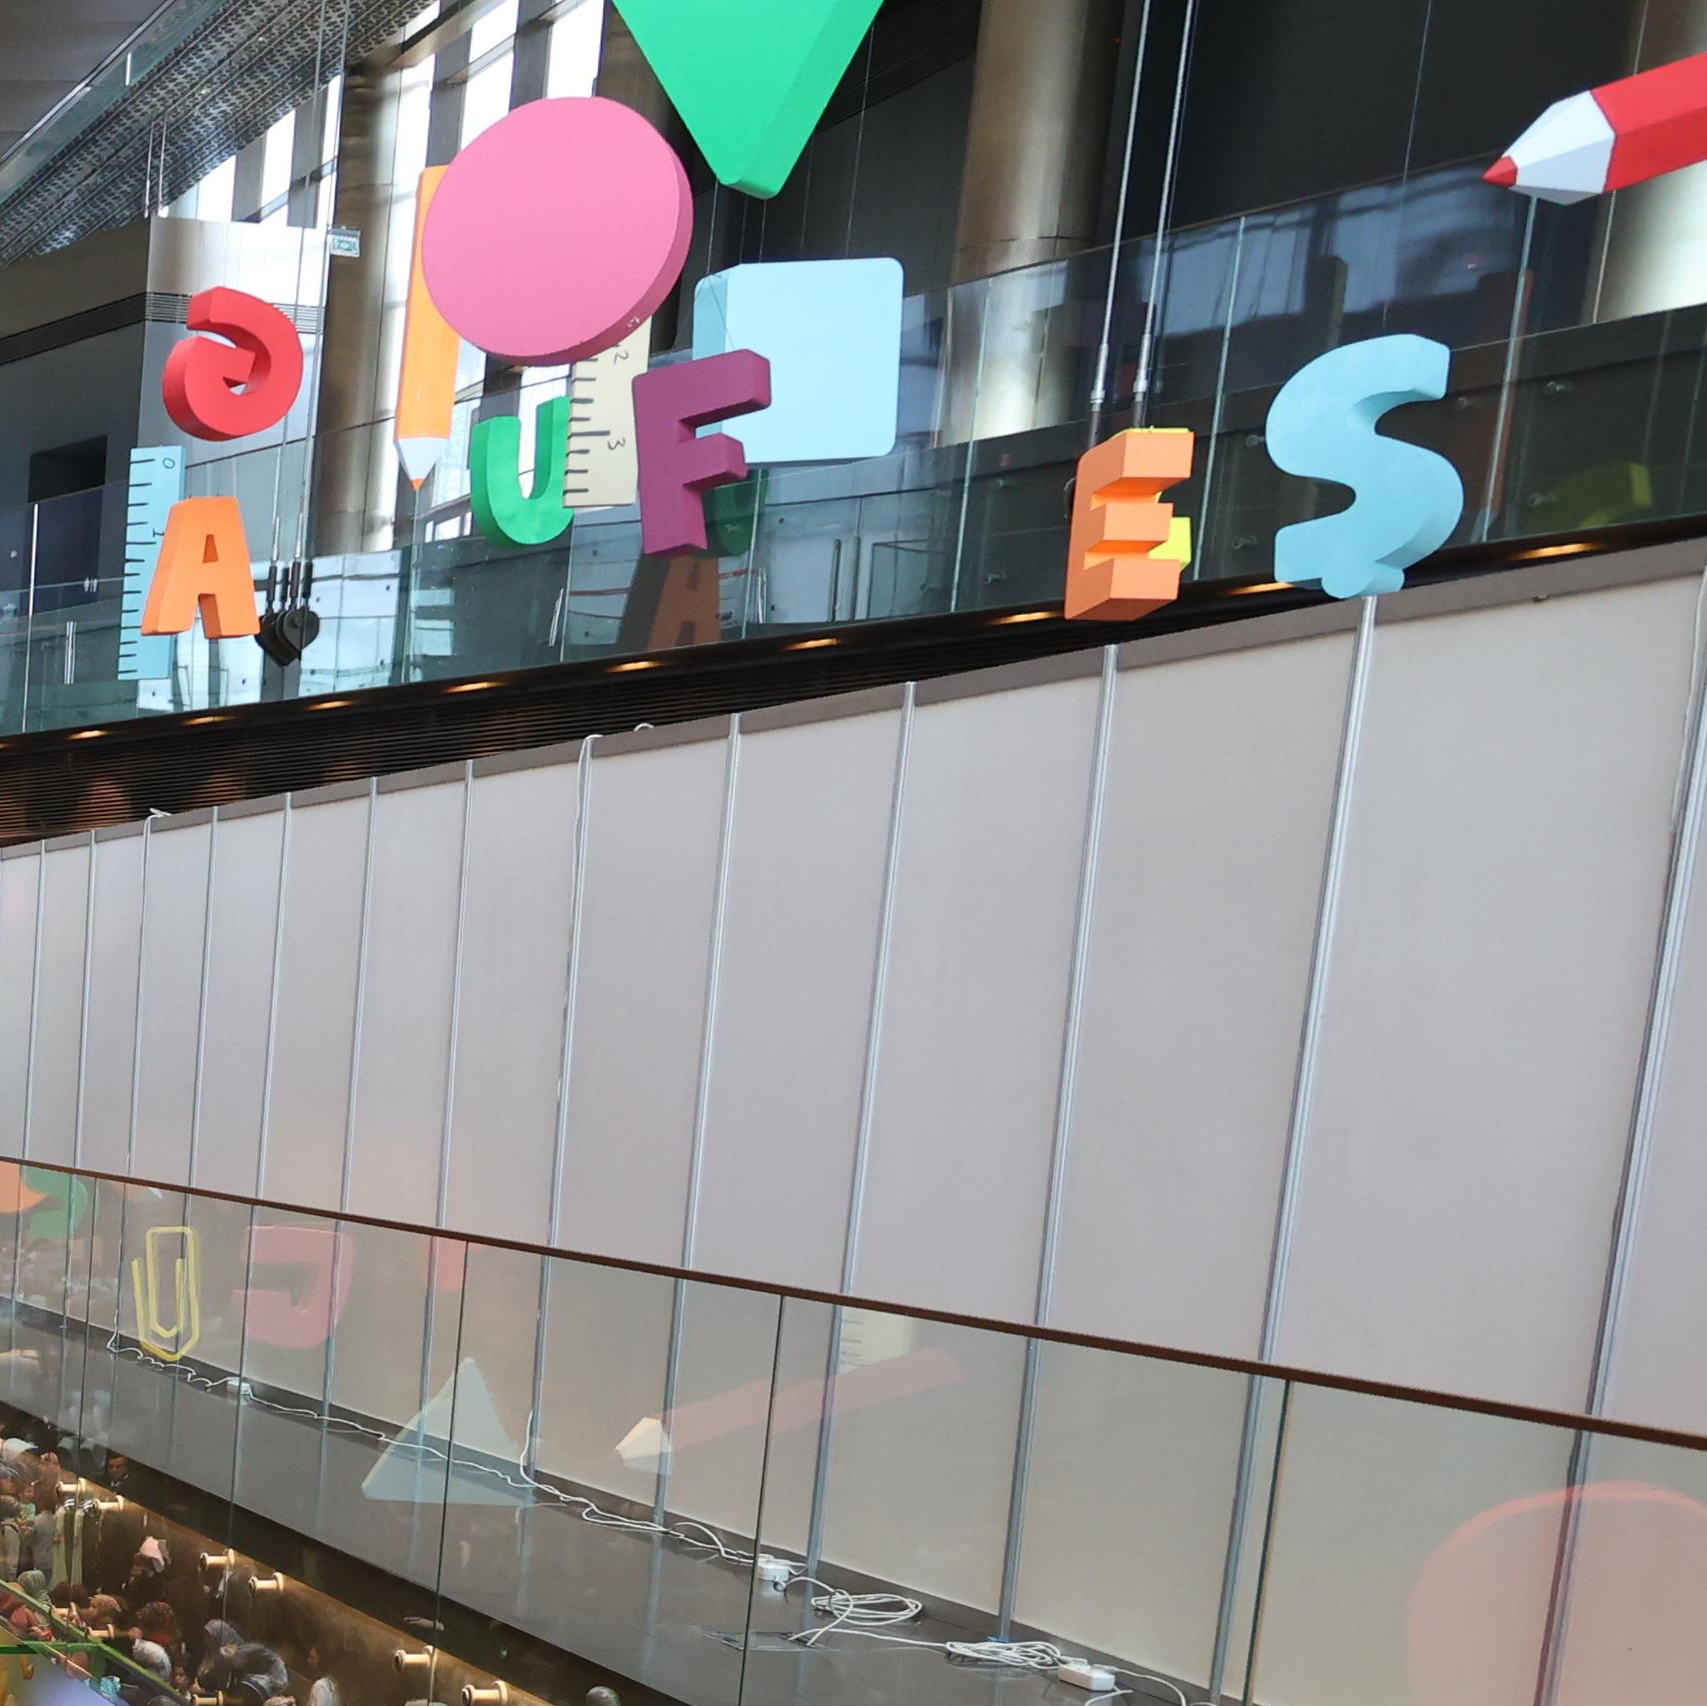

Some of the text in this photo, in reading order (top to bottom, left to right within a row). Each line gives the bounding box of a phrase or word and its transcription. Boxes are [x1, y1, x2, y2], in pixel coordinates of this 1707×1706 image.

[632, 349, 772, 558] F
[1065, 426, 1195, 621] E
[141, 495, 261, 640] A
